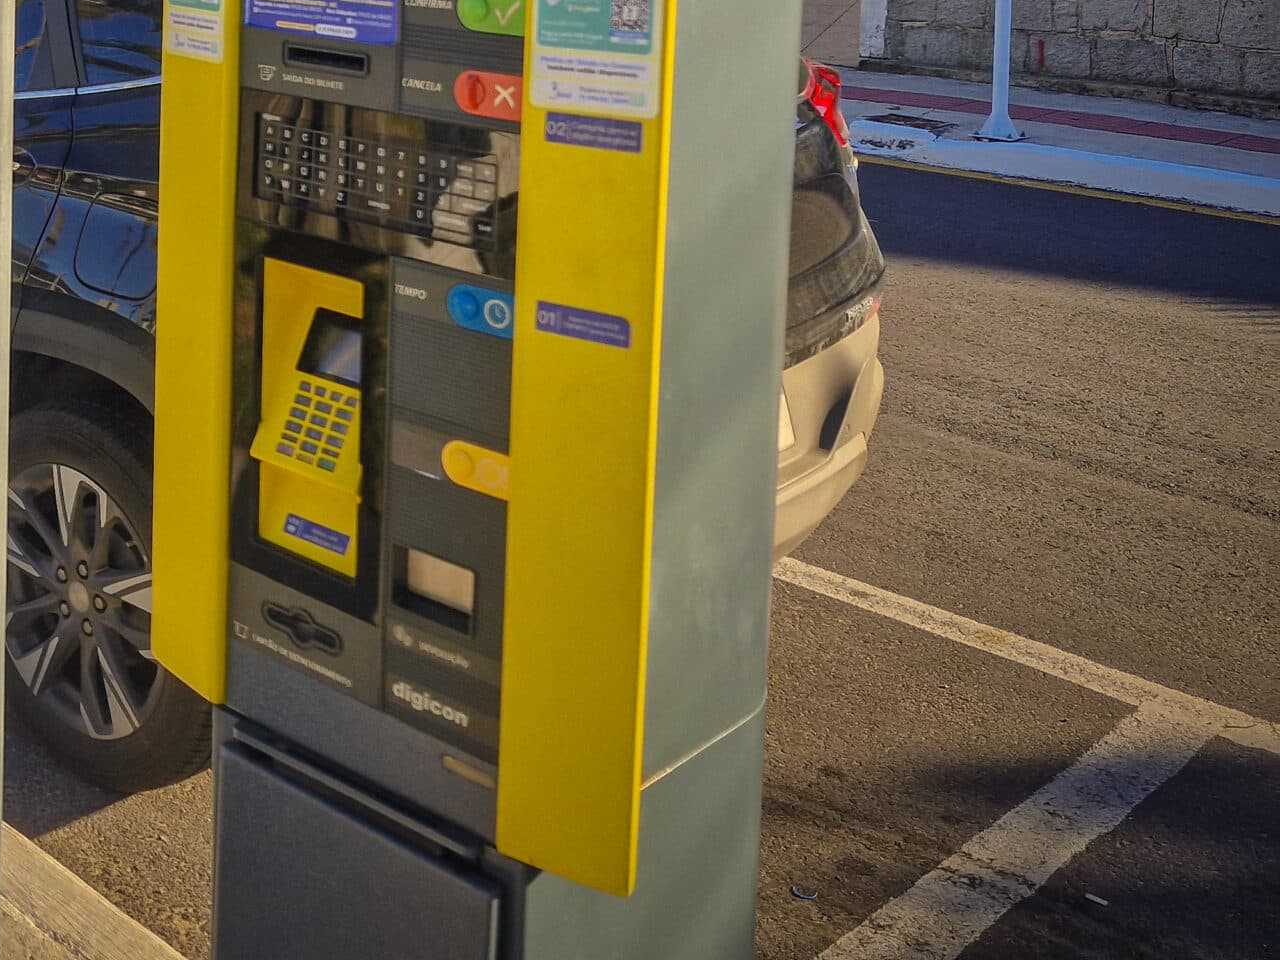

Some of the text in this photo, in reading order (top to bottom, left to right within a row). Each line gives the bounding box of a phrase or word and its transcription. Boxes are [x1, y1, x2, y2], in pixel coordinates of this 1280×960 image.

[401, 76, 442, 92] CANCELA
[546, 121, 567, 136] 02
[394, 283, 428, 300] TEMPO
[537, 310, 556, 326] 01
[392, 680, 469, 728] digicon
